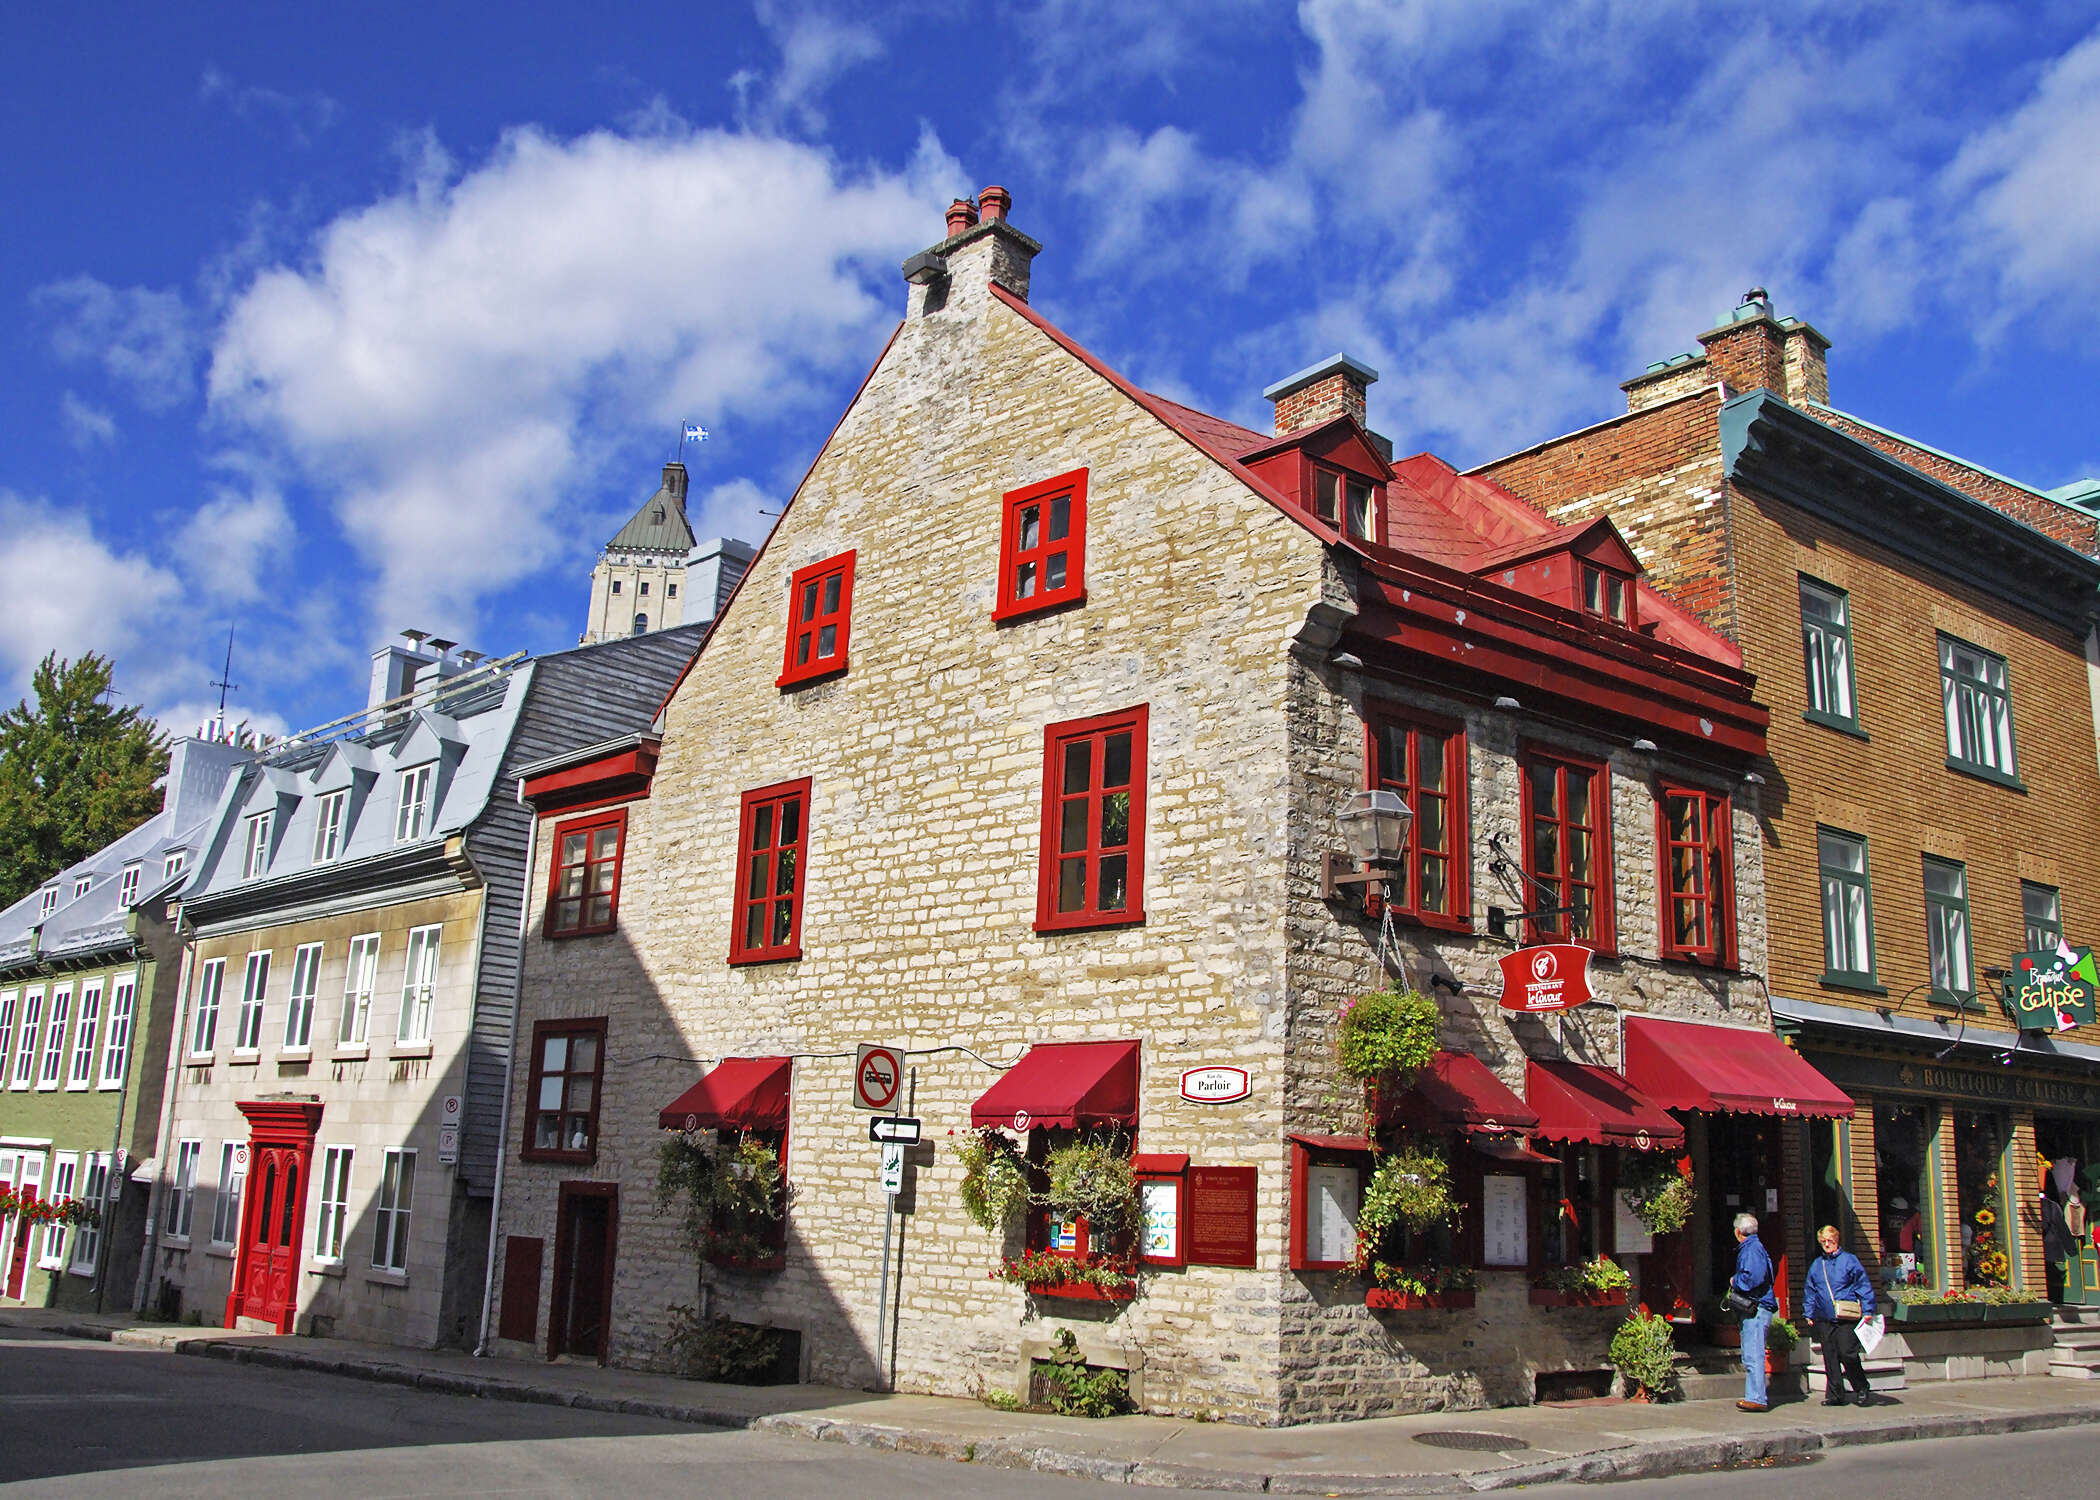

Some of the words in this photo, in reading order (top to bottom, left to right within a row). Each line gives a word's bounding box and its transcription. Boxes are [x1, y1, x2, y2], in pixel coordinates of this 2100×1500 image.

[2019, 985, 2086, 1016] Eclipse
[1198, 1079, 1231, 1090] Parloir
[1923, 1068, 2005, 1096] BOUTIQUE
